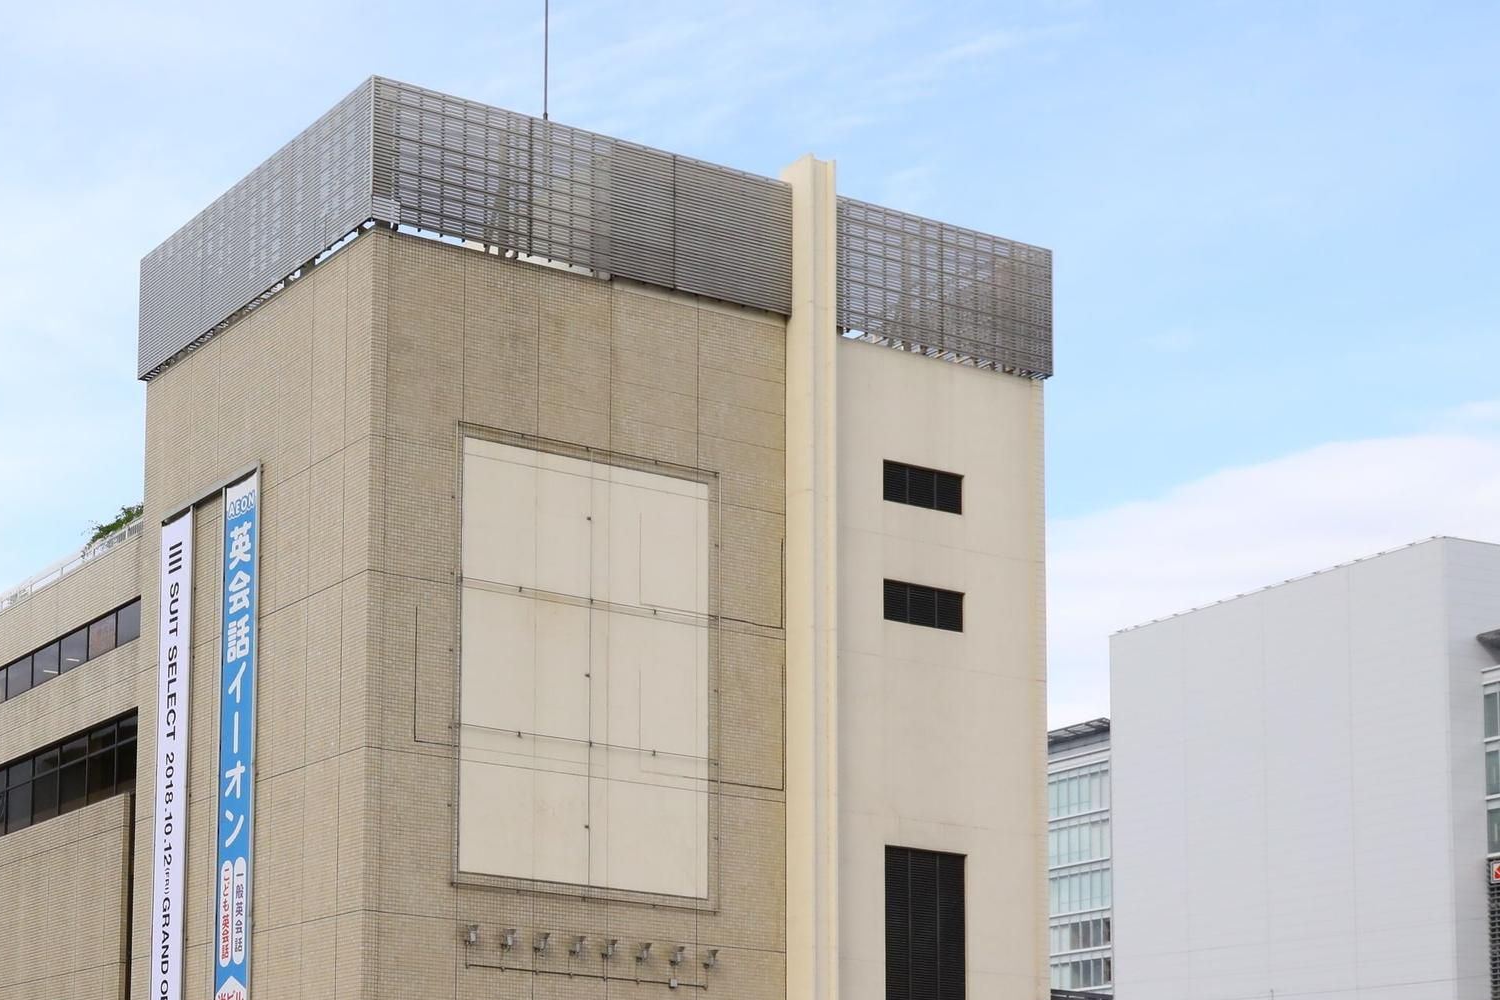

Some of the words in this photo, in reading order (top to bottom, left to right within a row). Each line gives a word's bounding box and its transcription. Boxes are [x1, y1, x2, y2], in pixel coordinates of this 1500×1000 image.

[227, 490, 255, 520] AEON
[168, 582, 180, 638] SUIT
[166, 645, 179, 741] SELECT
[225, 521, 251, 848] 英会話イーオン
[160, 897, 171, 976] GRAND
